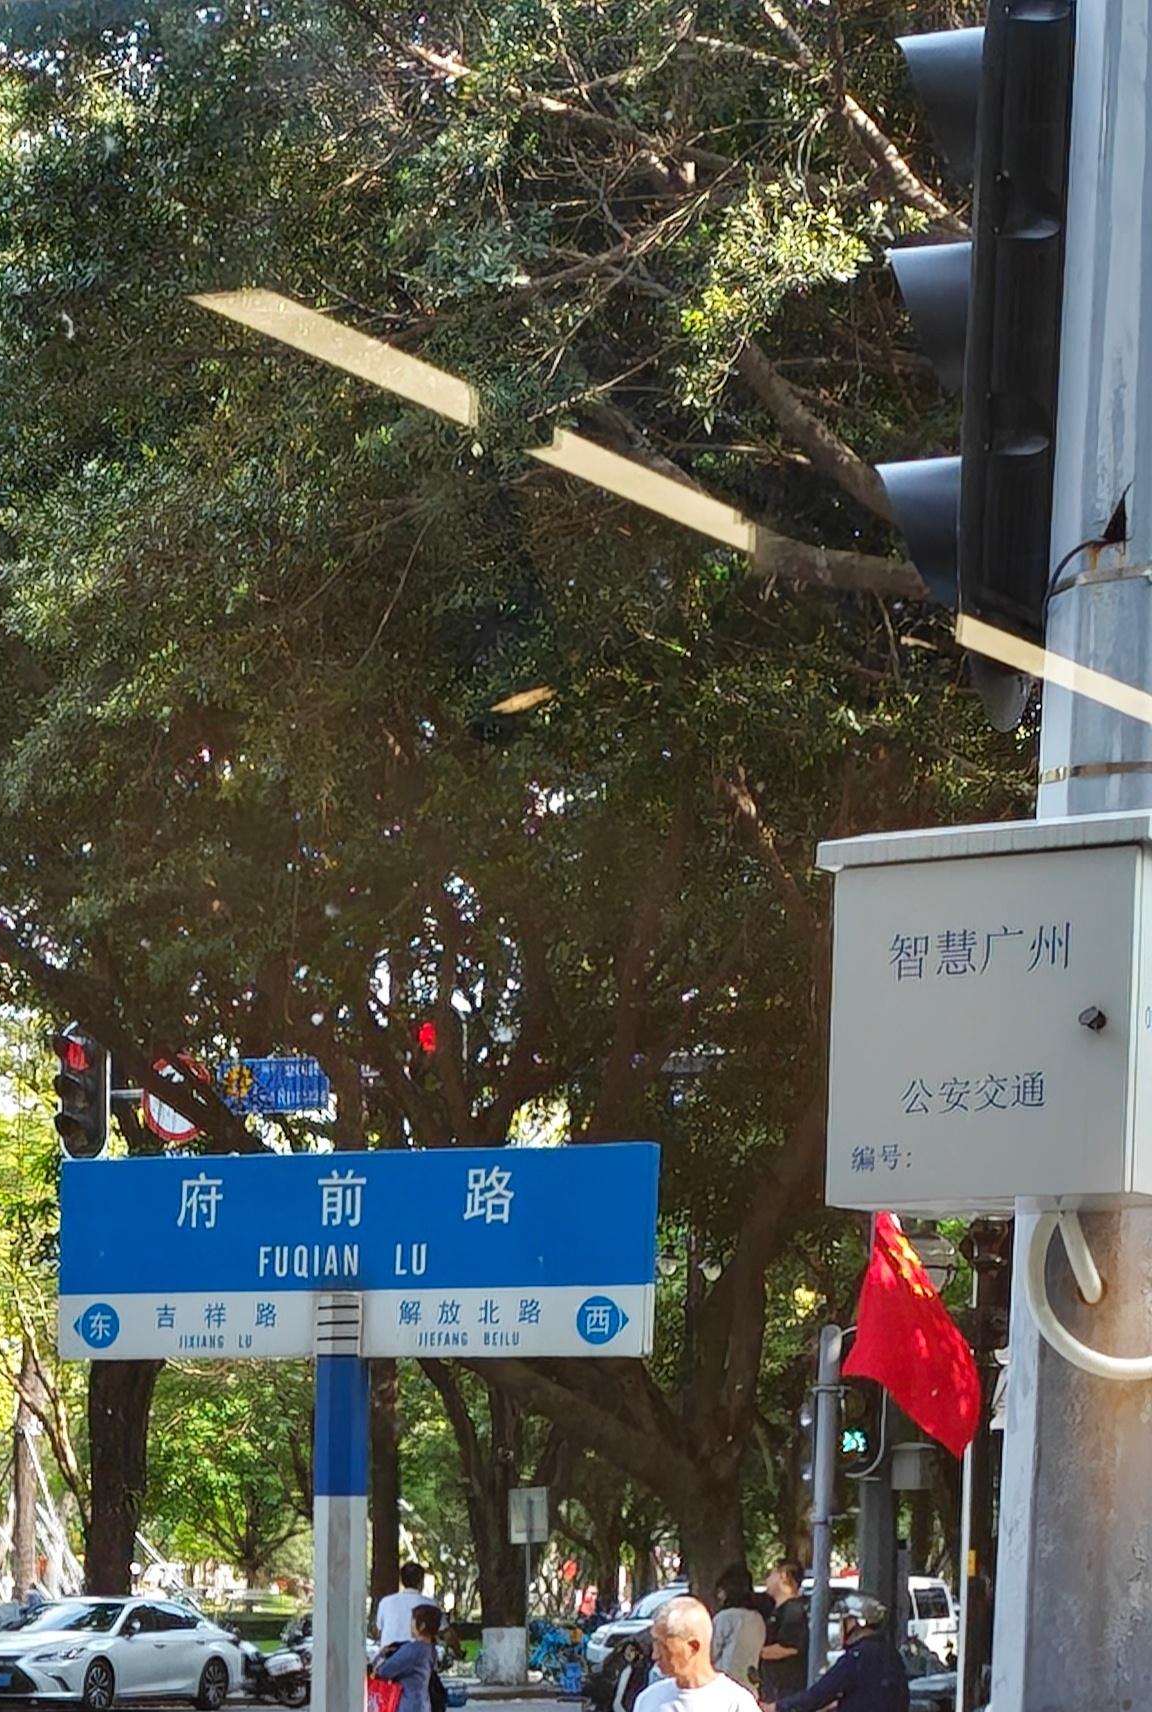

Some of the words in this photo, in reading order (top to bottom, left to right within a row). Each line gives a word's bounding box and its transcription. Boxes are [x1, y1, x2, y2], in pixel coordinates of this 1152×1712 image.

[889, 920, 1071, 981] 智慧广州
[901, 1071, 1047, 1115] 公安交通
[176, 1165, 515, 1229] 府前路
[259, 1244, 359, 1278] FUQIAN
[394, 1243, 427, 1276] LU
[88, 1311, 112, 1341] 东
[155, 1302, 278, 1329] 吉祥路
[399, 1298, 541, 1326] 解放北路
[585, 1304, 613, 1335] 西
[178, 1334, 225, 1350] JIXIANG
[238, 1335, 253, 1349] LU
[418, 1331, 469, 1348] JIEFANG
[483, 1331, 521, 1347] BEILU
